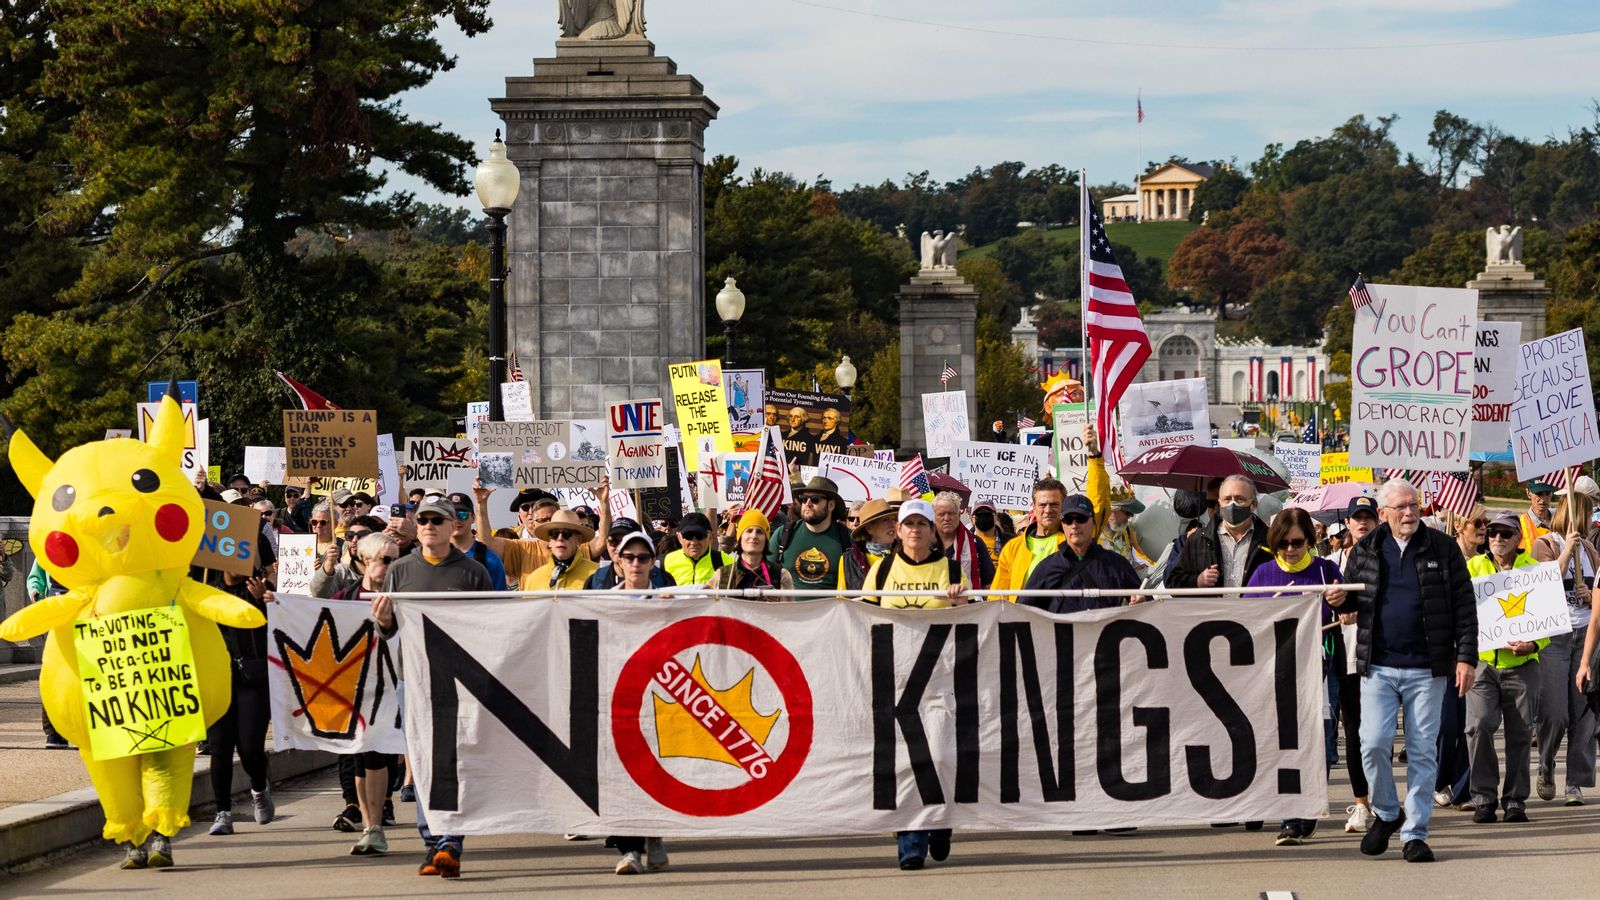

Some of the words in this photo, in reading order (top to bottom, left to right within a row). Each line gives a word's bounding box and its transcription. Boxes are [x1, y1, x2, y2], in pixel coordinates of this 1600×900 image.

[1475, 330, 1499, 348] NGS.
[1521, 329, 1582, 370] PROTEST
[671, 364, 698, 379] PUTIN
[1356, 346, 1474, 394] GROPE
[675, 389, 718, 407] RELEASE
[770, 396, 793, 404] Potential
[793, 398, 814, 406] Tyrants:
[797, 393, 821, 402] Founding
[286, 411, 335, 422] TRUMP
[343, 411, 355, 423] IS
[362, 412, 372, 423] A
[610, 401, 662, 433] UNITE
[688, 405, 707, 419] THE
[1358, 402, 1468, 427] DEMOCRACY
[1512, 405, 1532, 433] I
[1536, 384, 1584, 421] LOVE
[289, 423, 320, 433] LIAR
[480, 423, 515, 436] EVERY
[518, 422, 564, 436] PATRIOT
[687, 421, 720, 436] P-TAPE
[290, 435, 356, 447] EPSTEIN'S
[482, 437, 523, 447] SHOULD
[526, 437, 542, 447] BE
[1060, 436, 1083, 452] NO
[1138, 434, 1195, 447] ANTI-FASCISTS
[1364, 430, 1466, 463] DONALD!
[1519, 412, 1595, 468] AMERICA
[291, 448, 348, 459] BIGGEST
[410, 440, 435, 461] NO
[616, 440, 663, 458] AGAINST
[815, 443, 841, 455] WAY!
[957, 448, 960, 458] I
[966, 448, 991, 458] LIKE
[997, 450, 1017, 462] ICE
[1023, 454, 1035, 465] IN
[1275, 447, 1296, 455] Books
[1297, 448, 1321, 456] Banned
[292, 459, 336, 470] BUYER
[822, 454, 860, 467] APPROVAL
[863, 459, 898, 473] RATINGS
[1283, 455, 1309, 463] Exhibits
[515, 465, 605, 484] ANTI-FASCIST
[614, 464, 664, 481] TYRANNY
[970, 464, 987, 473] MY
[1296, 470, 1321, 478] Silenced
[315, 477, 348, 491] SINCE
[974, 479, 998, 489] NOT
[1004, 482, 1015, 491] IN
[1021, 483, 1033, 494] M
[1322, 475, 1351, 485] DUMP
[200, 534, 251, 560] NGS
[1474, 581, 1496, 599] NO
[1503, 567, 1561, 591] CROWNS
[75, 623, 105, 640] The
[1480, 626, 1503, 643] NO
[1509, 612, 1568, 636] CLOWNS
[132, 629, 173, 649] NOT
[108, 673, 126, 690] BE
[133, 671, 143, 686] A
[148, 664, 192, 685] KING
[88, 696, 124, 730] NO
[126, 683, 200, 724] KINGS
[870, 618, 1302, 811] KINGS!
[656, 661, 726, 729] SINCE
[718, 720, 772, 779] 1776
